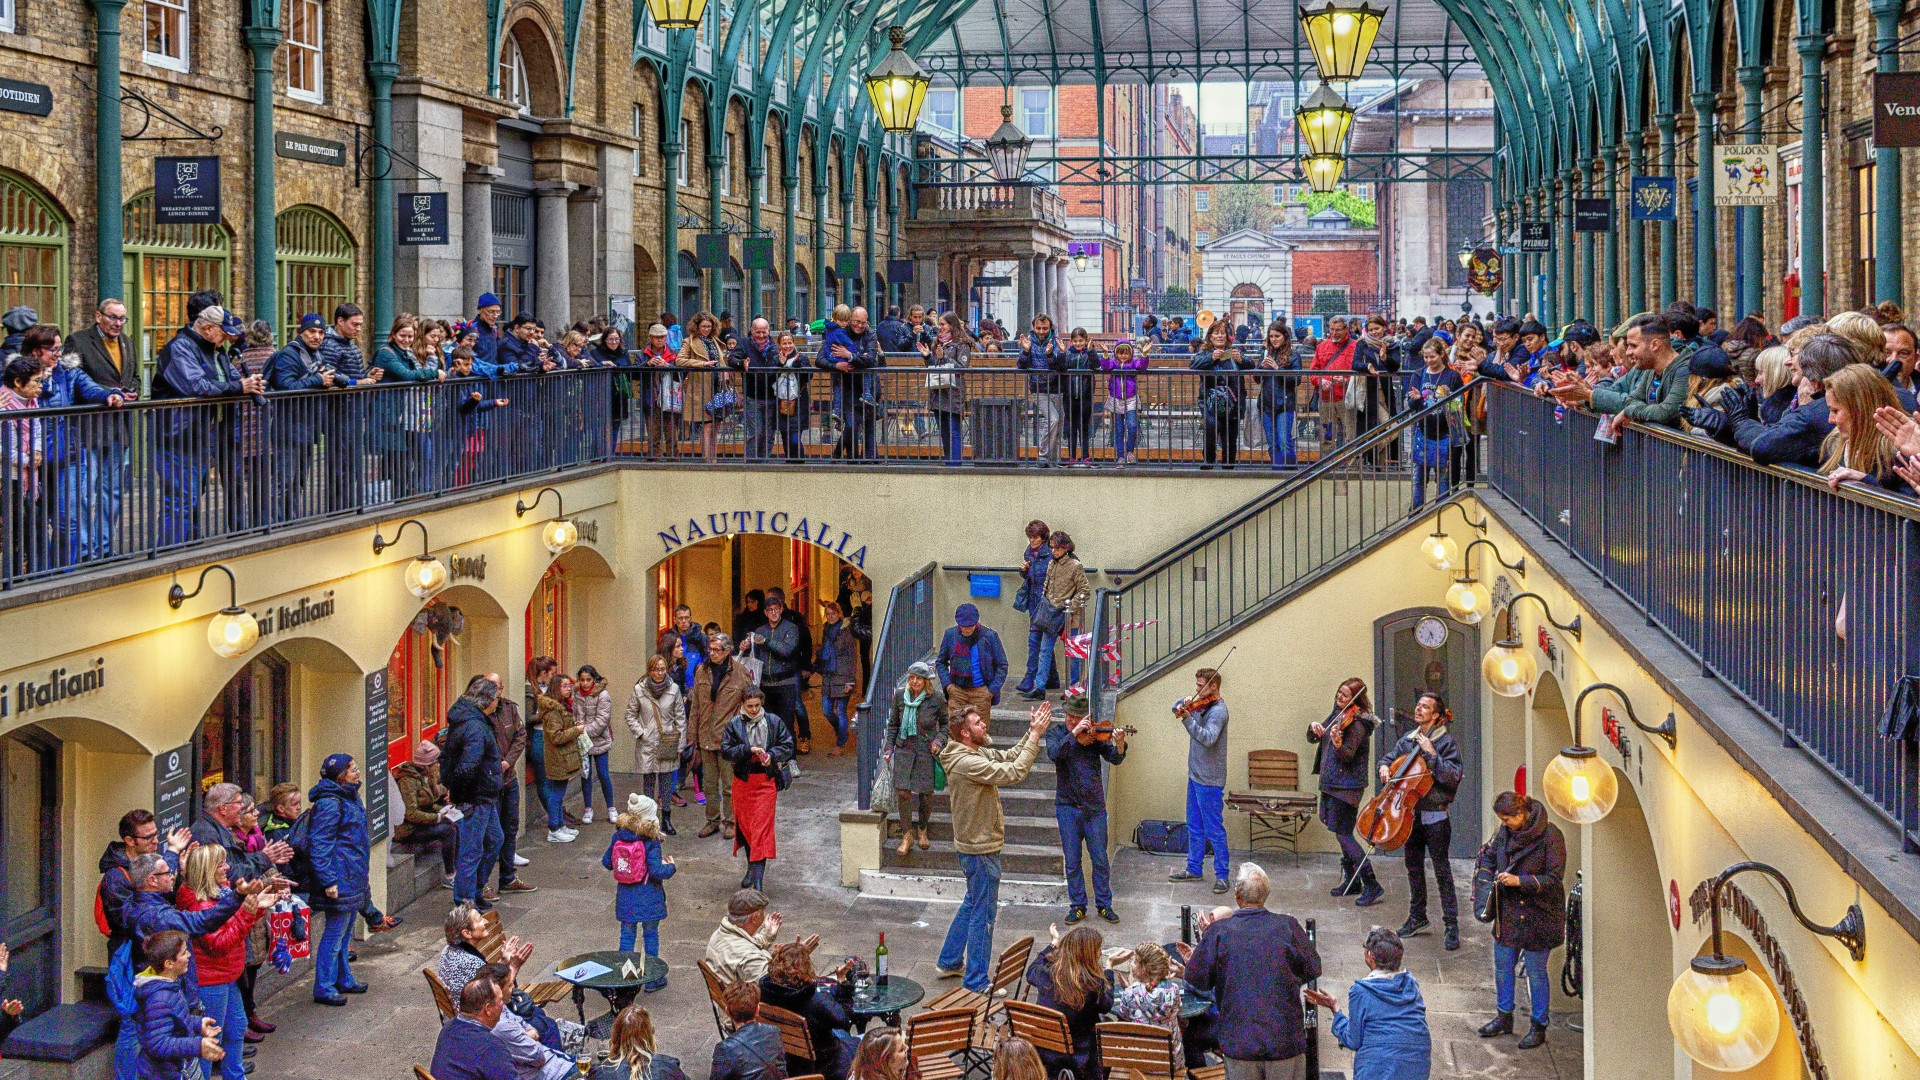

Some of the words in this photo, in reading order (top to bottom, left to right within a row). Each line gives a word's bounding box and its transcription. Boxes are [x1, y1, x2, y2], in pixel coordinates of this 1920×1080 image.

[285, 141, 294, 150] LE
[294, 142, 309, 152] PAIN
[309, 145, 339, 157] QUOTIDIEN
[1522, 239, 1549, 247] PYLONES
[657, 510, 869, 569] NAUTICALIA
[279, 589, 335, 630] Italiani
[18, 656, 105, 713] Italiani
[162, 815, 174, 826] Open
